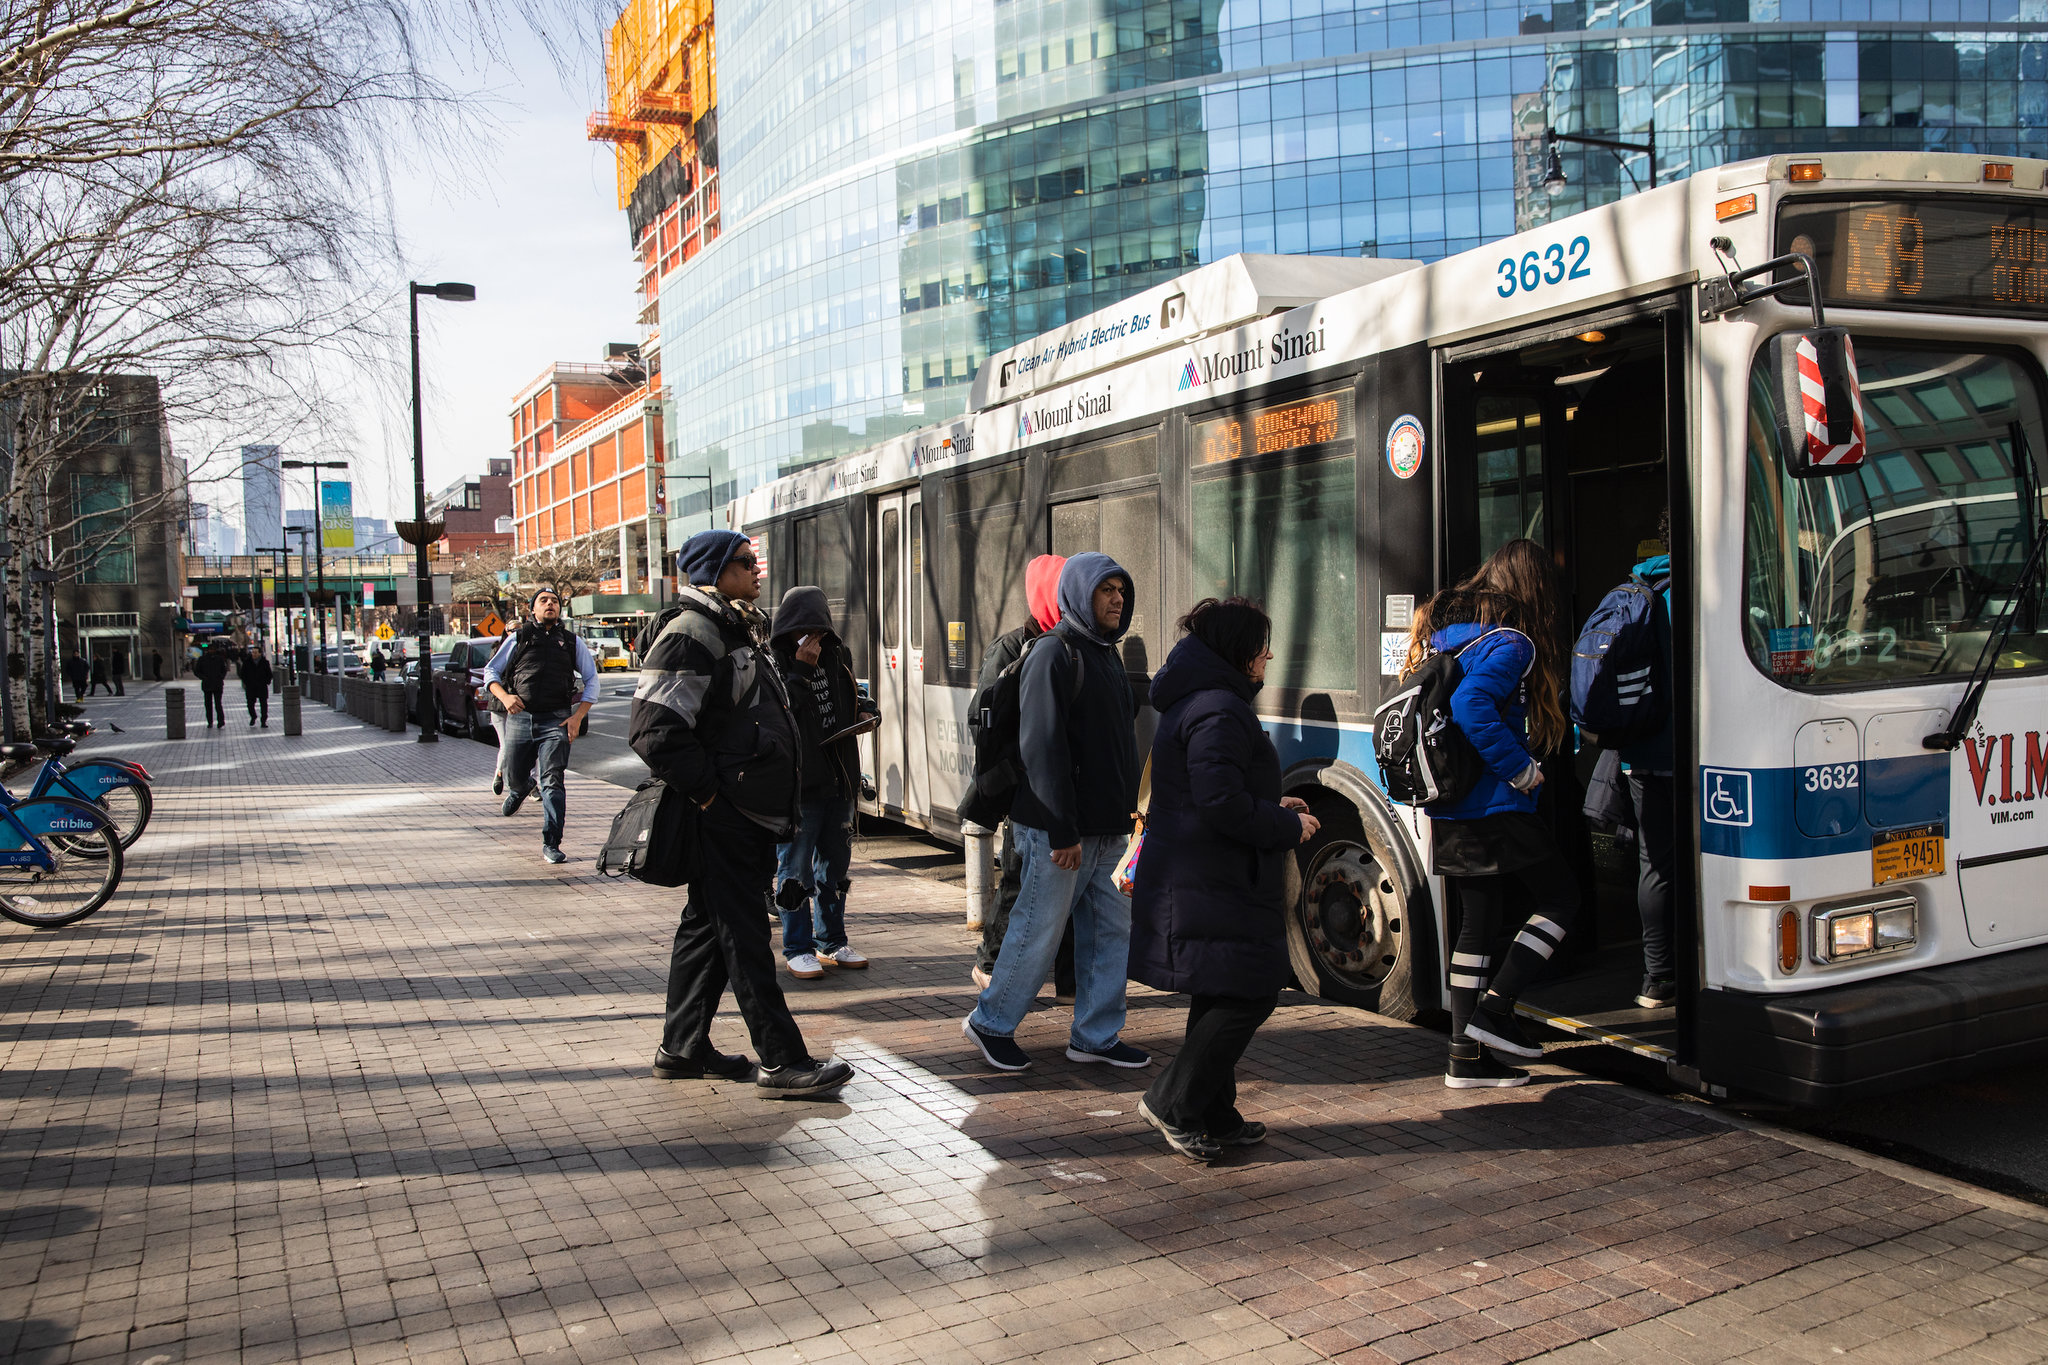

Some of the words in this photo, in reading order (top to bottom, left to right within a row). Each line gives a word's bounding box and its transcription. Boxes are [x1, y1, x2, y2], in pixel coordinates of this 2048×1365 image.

[1497, 235, 1591, 299] 3632
[1017, 354, 1040, 375] Clean
[1041, 347, 1055, 365] Air
[1056, 332, 1089, 361] Hybrid
[1089, 319, 1127, 348] Electric
[1130, 313, 1151, 334] Bus
[1203, 340, 1264, 385] Mount
[1271, 317, 1326, 366] Sinai
[1034, 394, 1075, 434] Mount
[1077, 385, 1112, 421] Sinai
[1255, 399, 1338, 436] RIDGEWOOD
[920, 444, 948, 466] Mount
[951, 429, 974, 457] Sinai
[1256, 427, 1311, 454] COOPER
[1316, 421, 1338, 443] AV
[838, 468, 859, 490] Mount
[860, 460, 878, 483] Sinai
[323, 504, 352, 519] LIC
[323, 519, 352, 530] QNS
[937, 719, 965, 745] EVEN
[1975, 720, 1986, 748] TEAM
[98, 775, 112, 784] citi
[112, 776, 129, 784] bike
[1805, 764, 1859, 792] 3632
[49, 818, 68, 829] citi
[69, 818, 93, 829] bike
[1990, 810, 2034, 825] VIM.com
[1890, 833, 1908, 841] NEW
[1909, 828, 1928, 838] YORK
[1911, 838, 1940, 867] 9451
[1896, 871, 1908, 879] NEW
[1909, 868, 1924, 877] YORK
